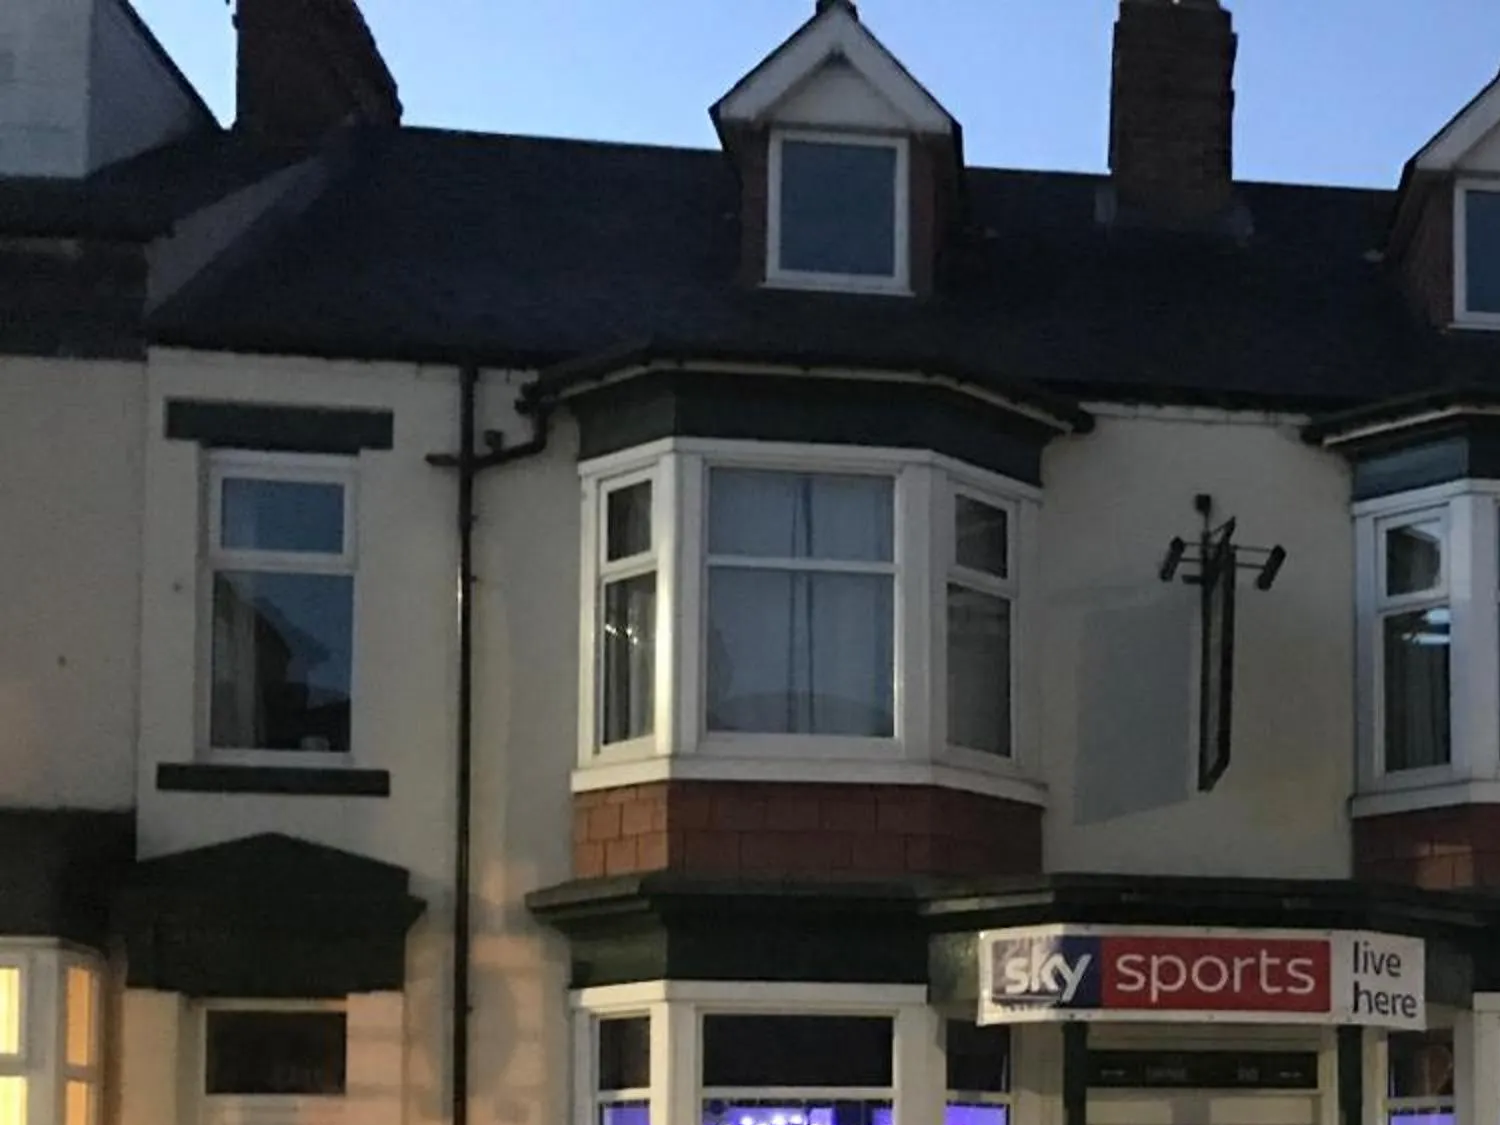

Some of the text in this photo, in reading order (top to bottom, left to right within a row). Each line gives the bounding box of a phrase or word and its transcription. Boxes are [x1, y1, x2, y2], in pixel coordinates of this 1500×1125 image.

[1005, 941, 1316, 1003] sky sports
[1352, 941, 1402, 977] live
[1352, 982, 1418, 1018] here
